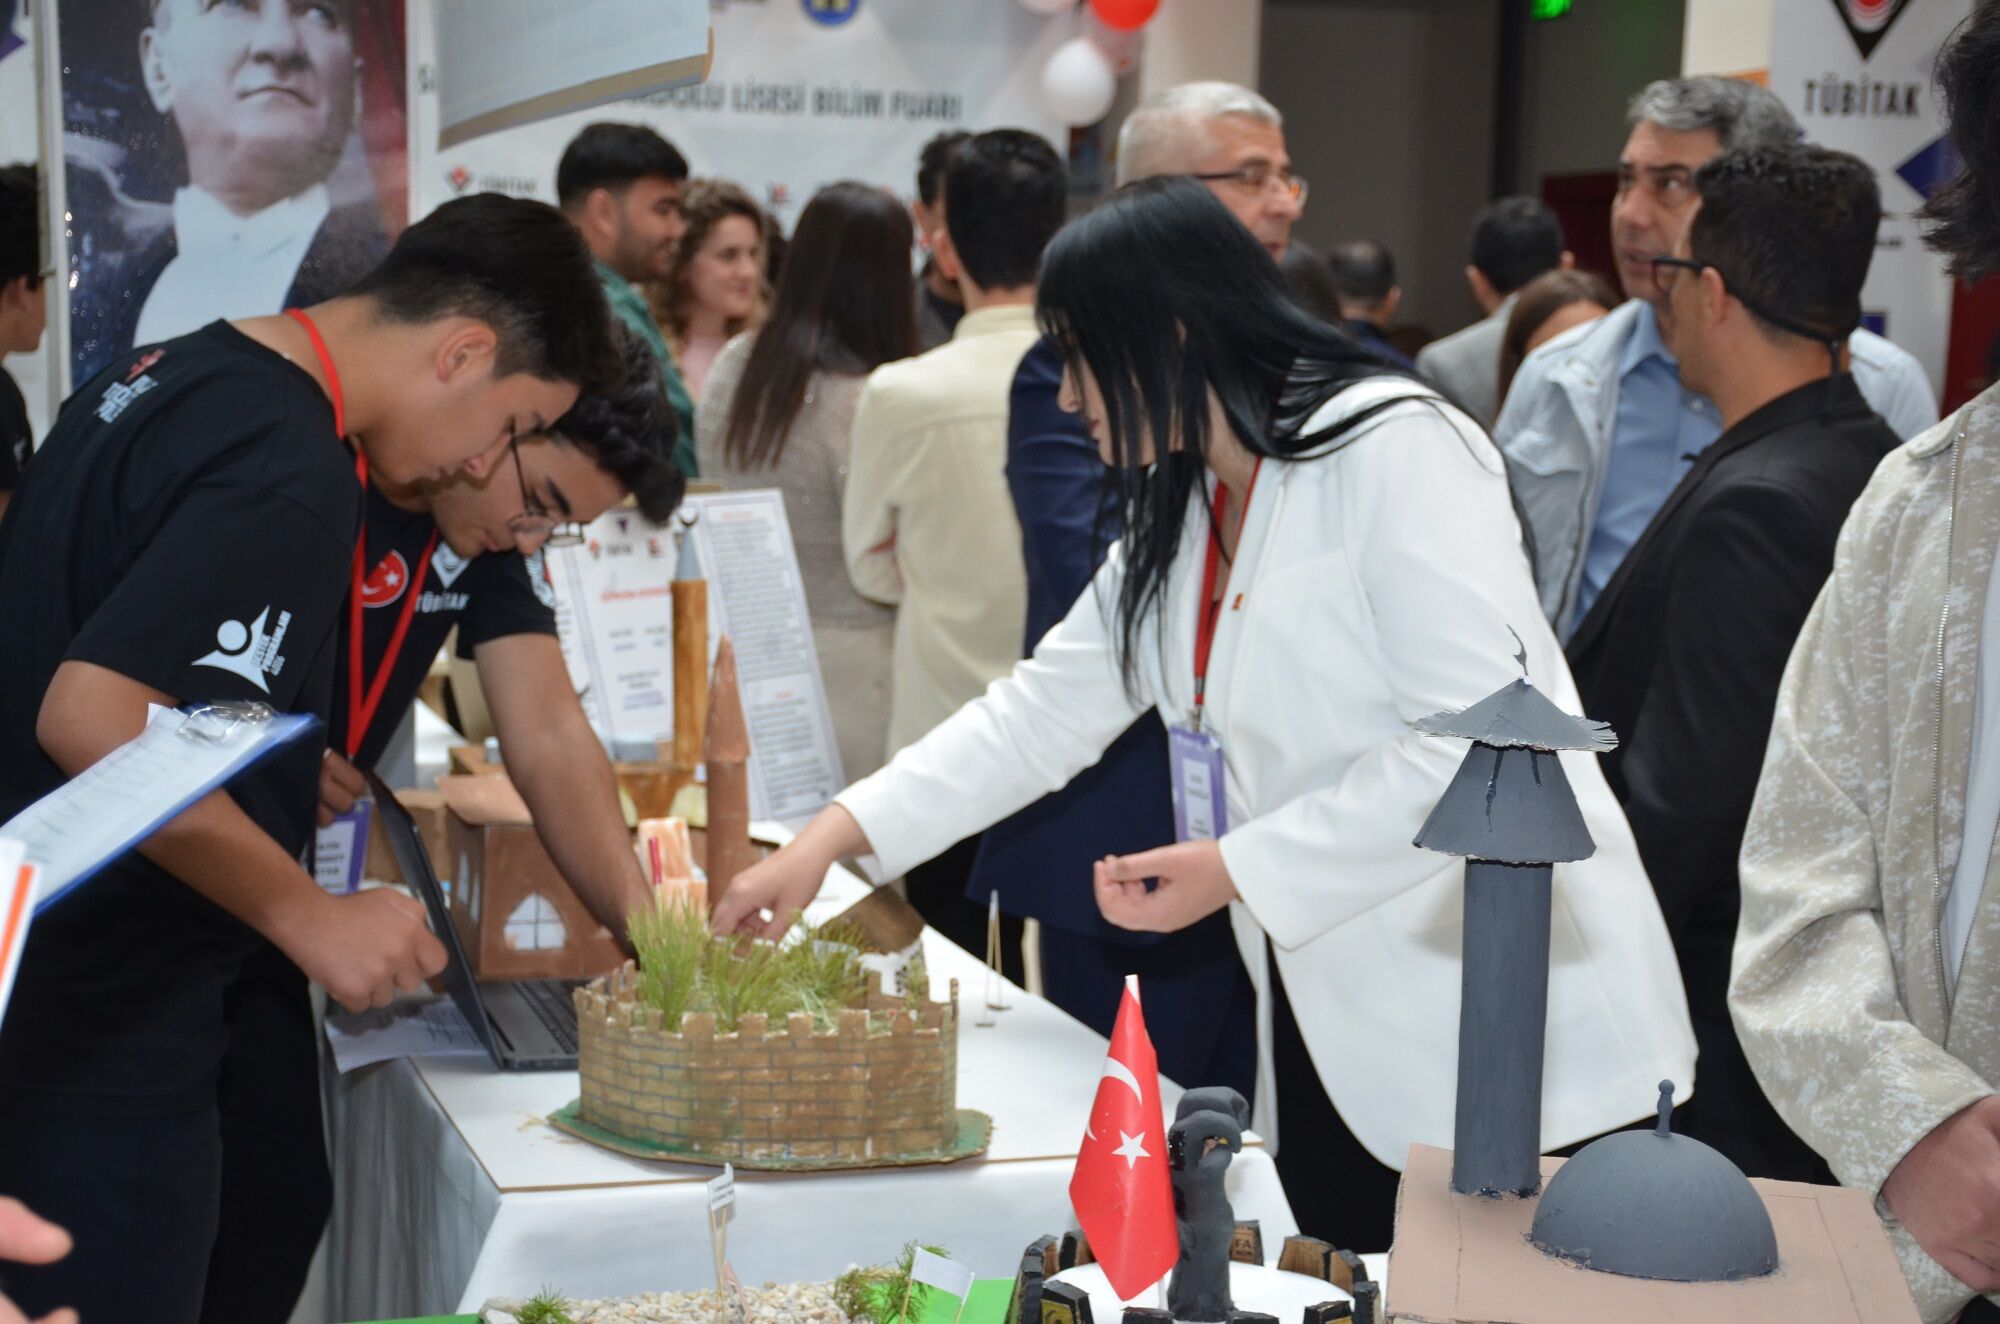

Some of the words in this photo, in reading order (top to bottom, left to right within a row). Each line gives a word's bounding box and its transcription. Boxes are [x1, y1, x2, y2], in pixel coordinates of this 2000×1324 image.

[733, 76, 804, 113] LİSESİ
[813, 80, 883, 117] BİLİM
[890, 90, 960, 120] FUARI
[1803, 73, 1920, 117] TÜBİTAK
